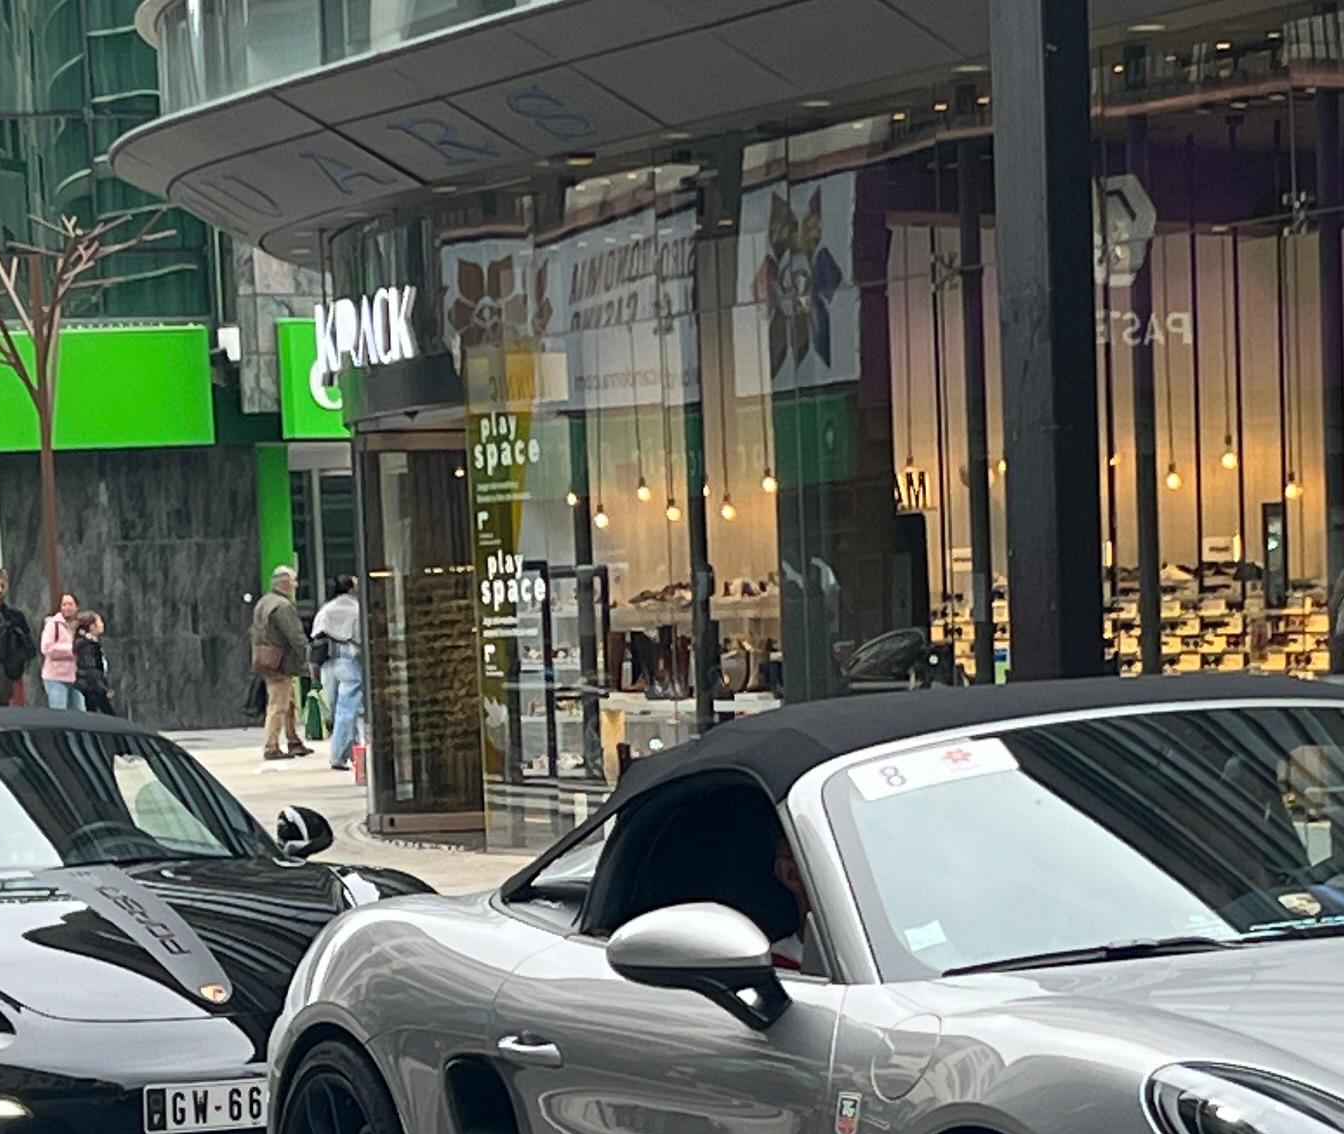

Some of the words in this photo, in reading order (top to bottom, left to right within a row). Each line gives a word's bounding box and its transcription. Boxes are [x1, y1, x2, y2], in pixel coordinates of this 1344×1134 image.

[315, 285, 416, 371] KRACK
[480, 410, 516, 444] play
[474, 439, 541, 476] space
[487, 549, 523, 580] play
[480, 577, 546, 612] space
[879, 765, 907, 787] 8
[172, 1086, 262, 1126] GW-66
